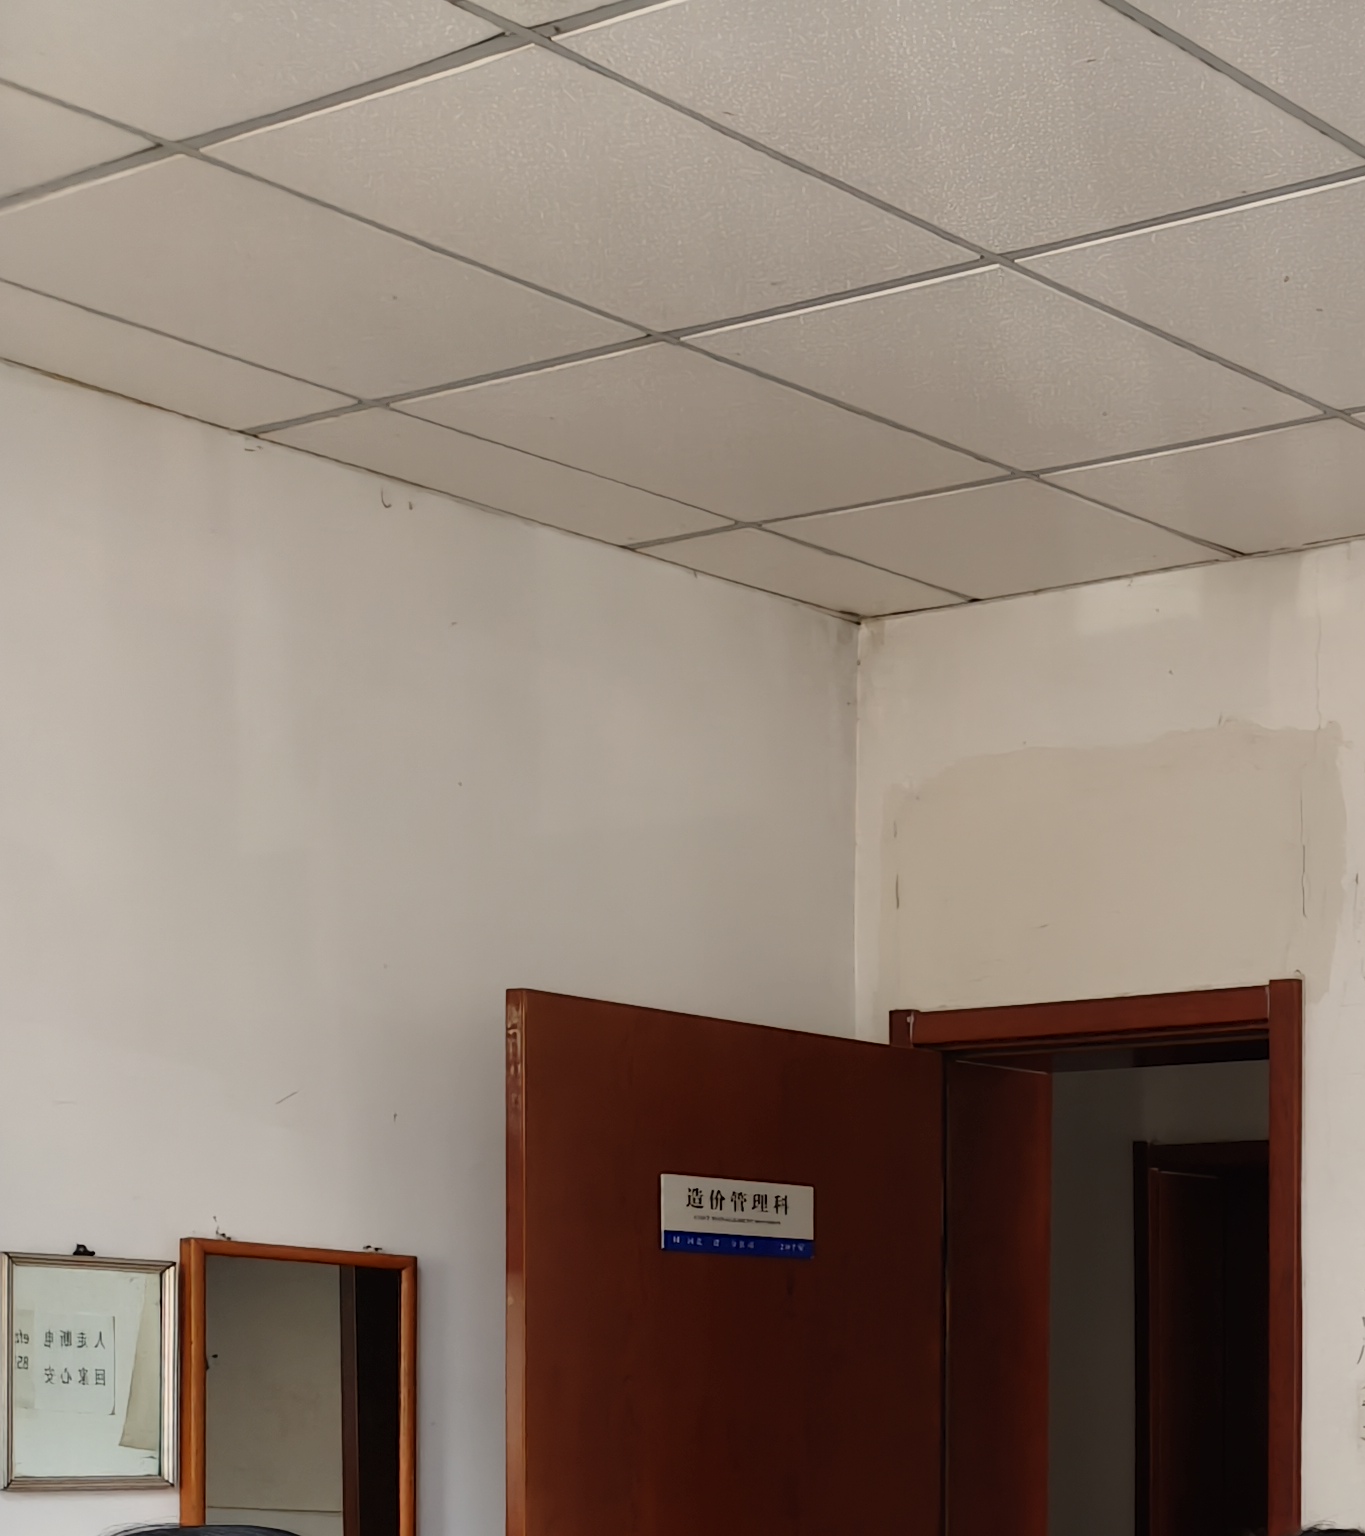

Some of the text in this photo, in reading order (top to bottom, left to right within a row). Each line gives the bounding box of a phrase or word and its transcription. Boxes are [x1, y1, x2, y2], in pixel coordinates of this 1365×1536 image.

[686, 1187, 789, 1216] 造价管理科
